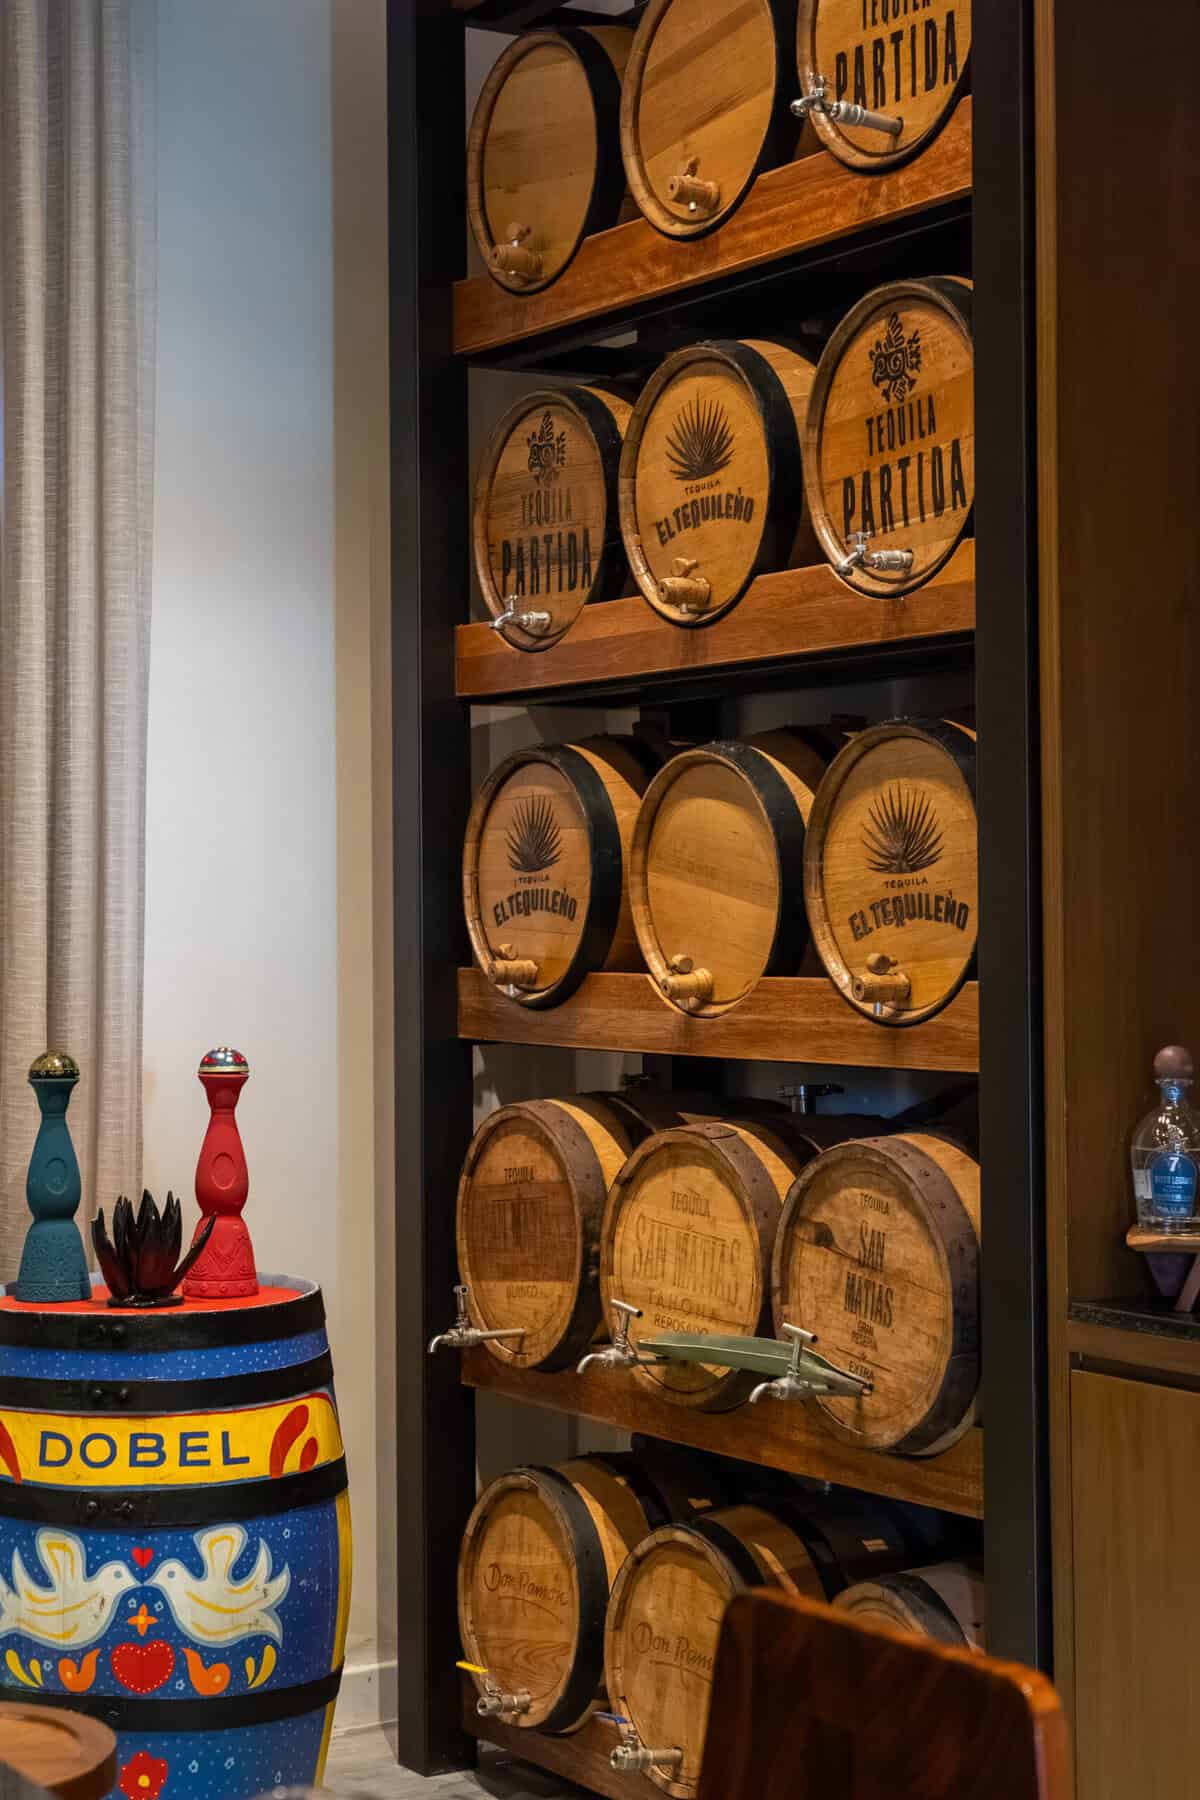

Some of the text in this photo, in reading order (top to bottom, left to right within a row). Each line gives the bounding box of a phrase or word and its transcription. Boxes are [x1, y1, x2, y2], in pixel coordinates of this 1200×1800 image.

[835, 10, 958, 110] PARTIDA
[865, 391, 937, 457] TEQUILA
[521, 487, 573, 528] TEQUILA
[684, 478, 722, 497] TEQUILA
[841, 437, 968, 545] PARTIDA
[655, 486, 755, 547] EL TEQUILEÑO
[501, 526, 592, 599] PARTIDA
[884, 876, 929, 889] TEQUILA
[492, 886, 578, 929] EL TEQUILEÑO
[847, 888, 971, 943] EL TEQUILEÑO
[1168, 1156, 1181, 1173] 7
[671, 1190, 712, 1218] TEQUILA
[858, 1219, 886, 1273] SAN
[843, 1271, 895, 1330] MATIAS
[38, 1430, 250, 1469] DOBEL
[631, 1622, 670, 1655] Don
